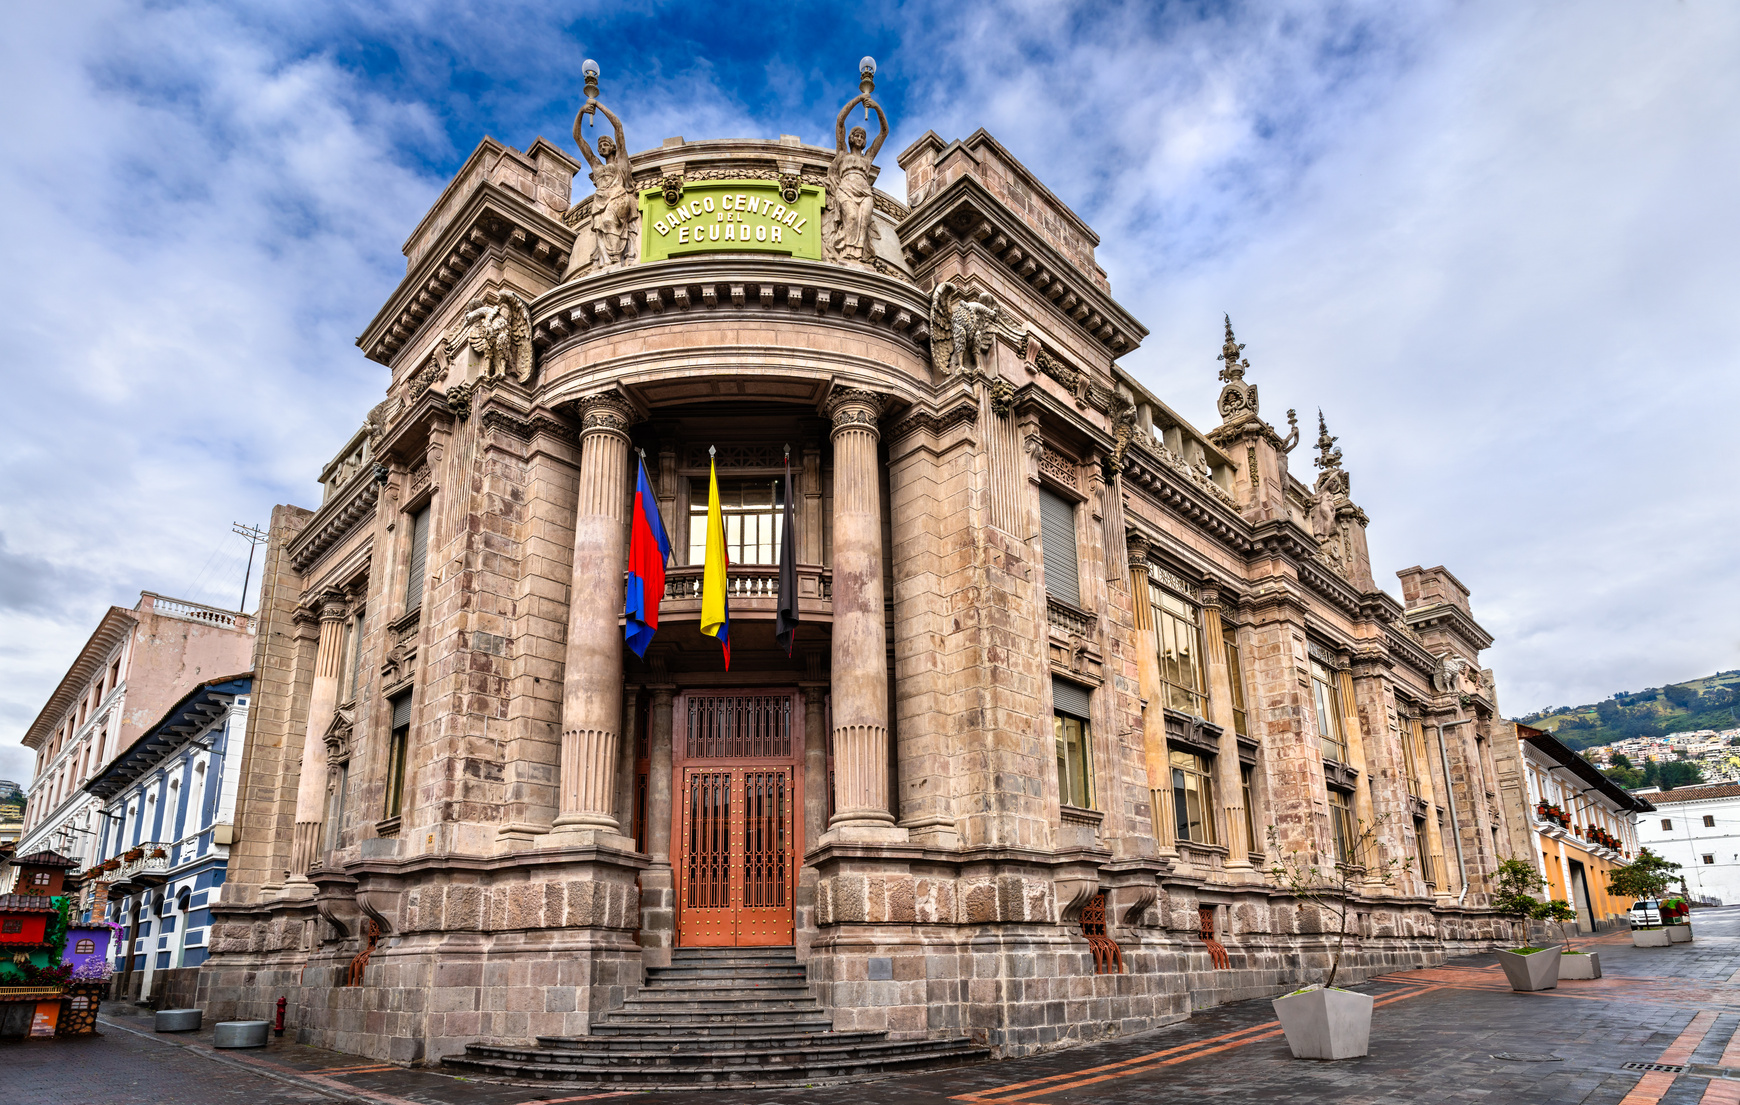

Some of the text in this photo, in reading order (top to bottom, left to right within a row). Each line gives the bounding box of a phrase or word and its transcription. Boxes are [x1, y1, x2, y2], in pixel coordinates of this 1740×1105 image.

[653, 194, 808, 236] BANCO CENTRAL
[717, 212, 743, 222] DEL
[679, 224, 783, 244] ECUADOR
